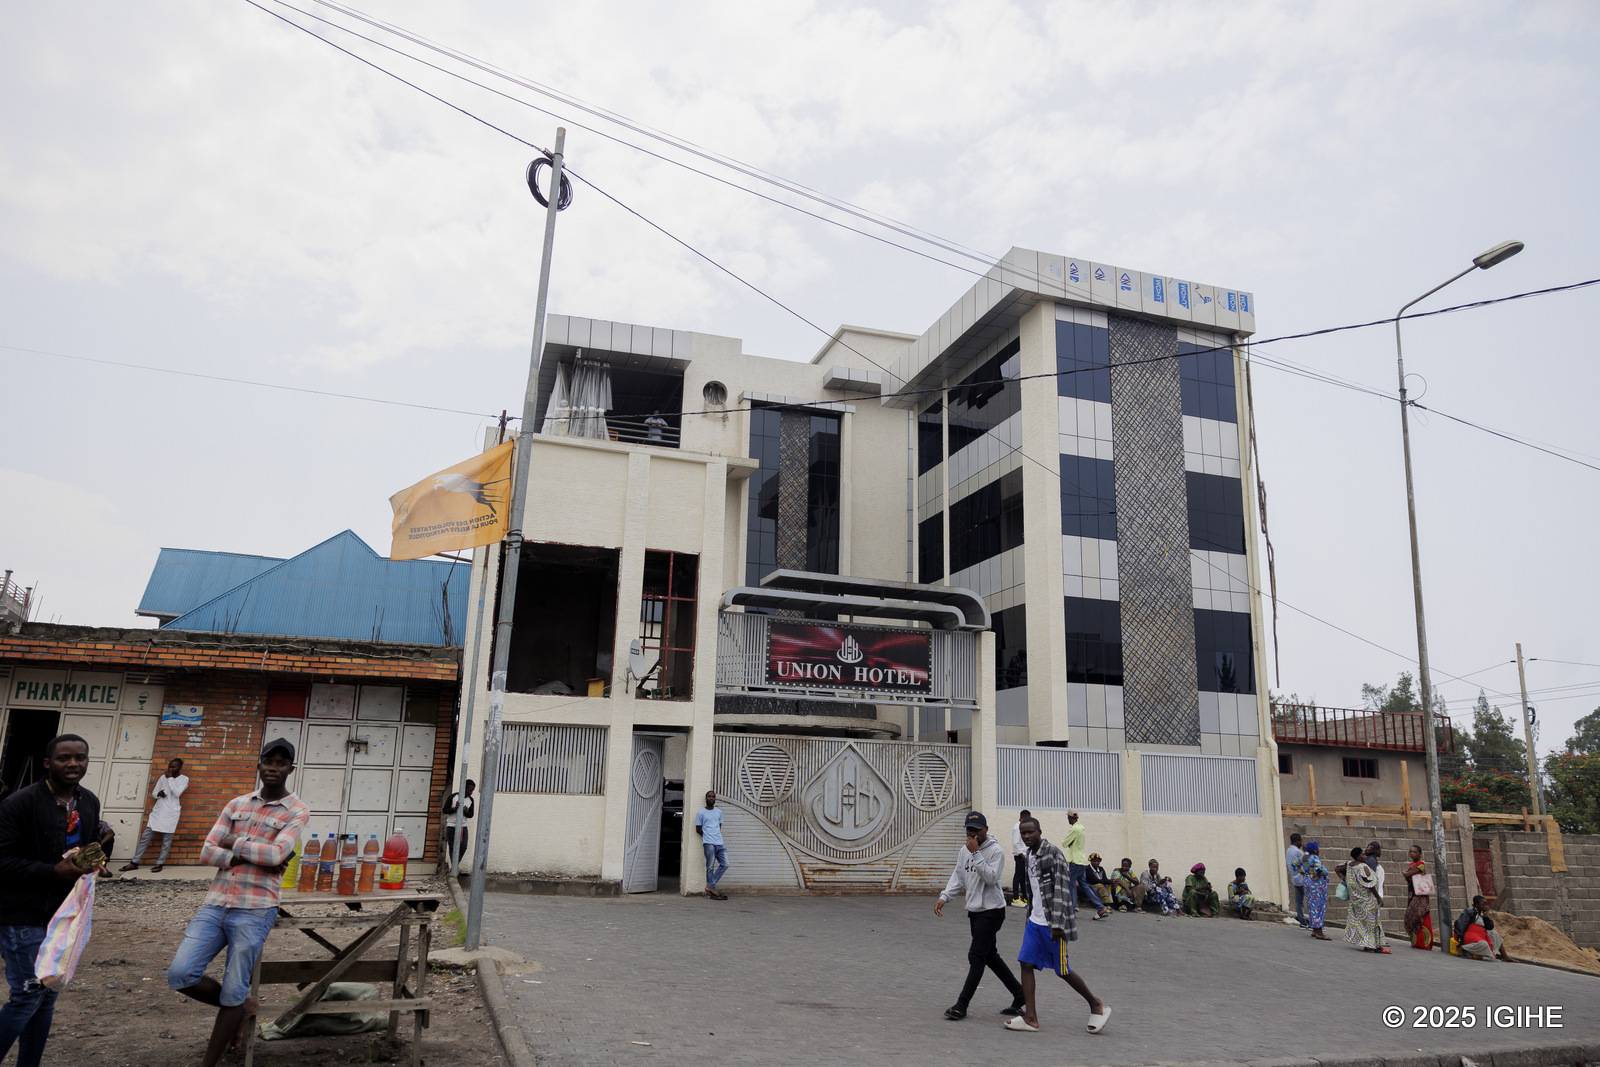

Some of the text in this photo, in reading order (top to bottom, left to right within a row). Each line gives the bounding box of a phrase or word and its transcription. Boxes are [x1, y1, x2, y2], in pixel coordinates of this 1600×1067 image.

[776, 660, 921, 686] UNION HOTEL
[15, 681, 118, 704] PHARMACIE
